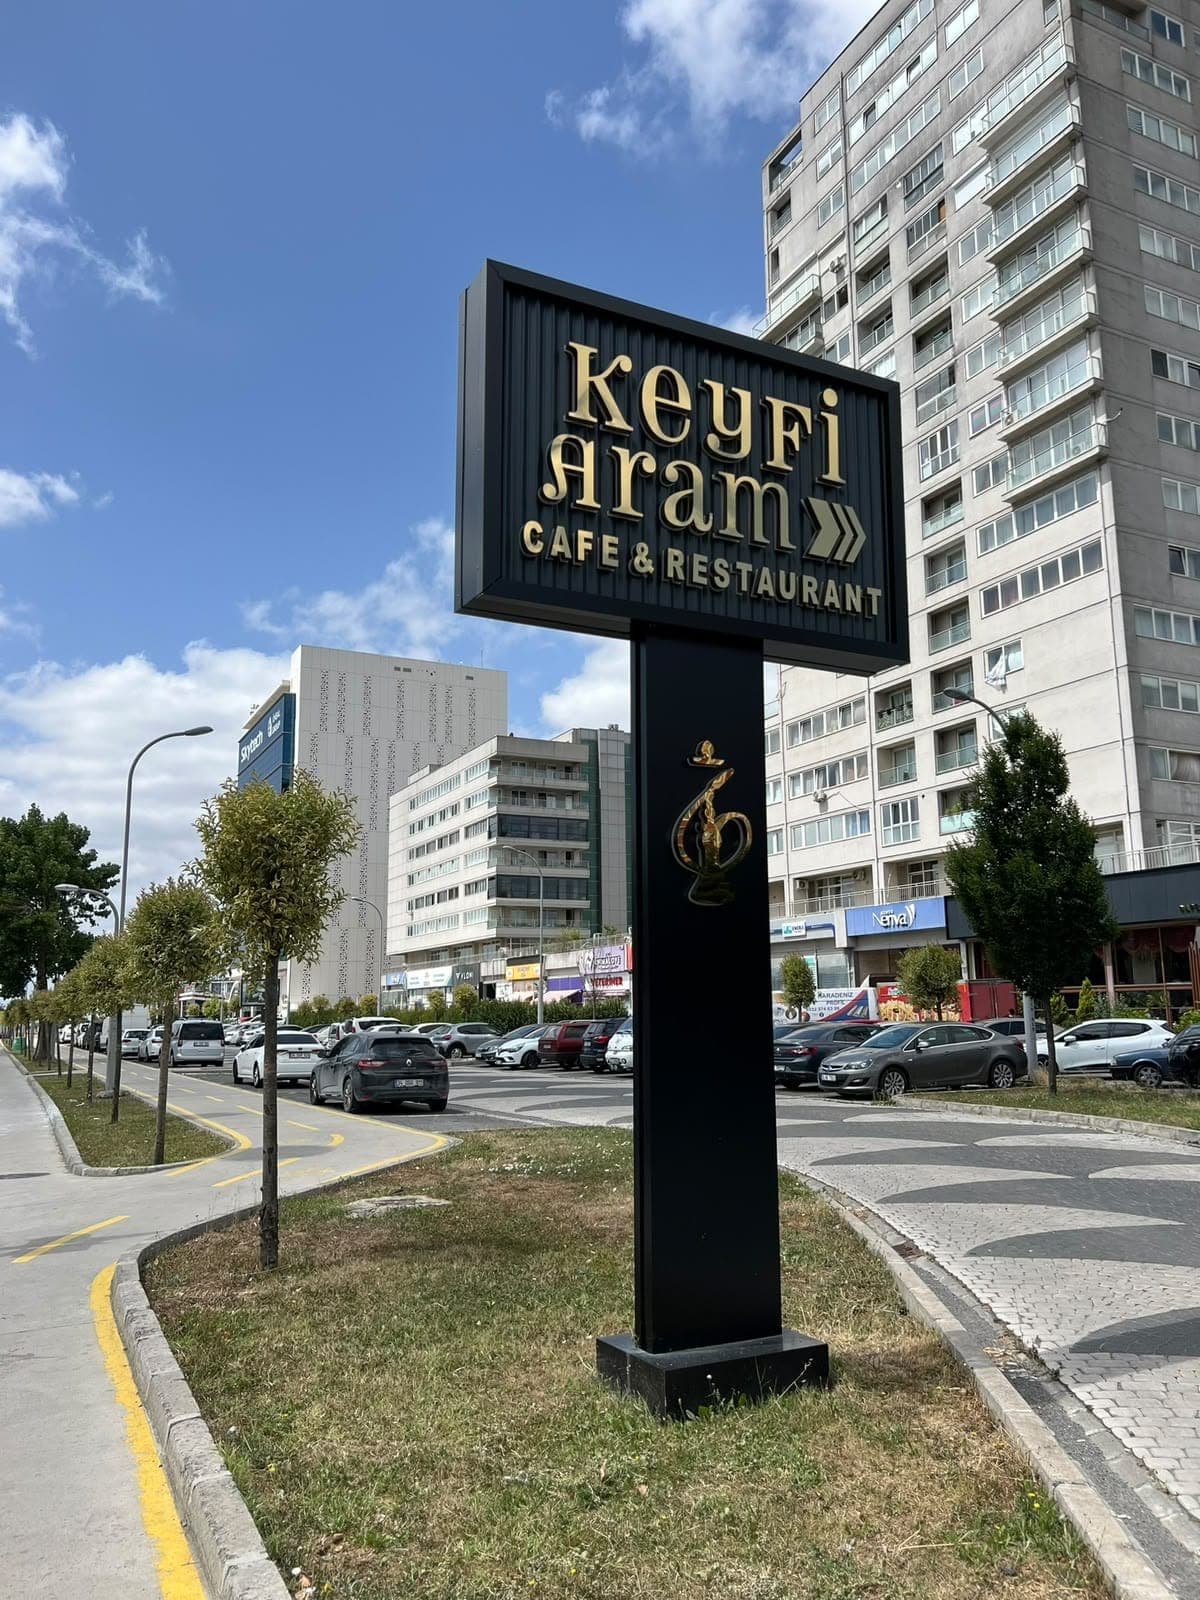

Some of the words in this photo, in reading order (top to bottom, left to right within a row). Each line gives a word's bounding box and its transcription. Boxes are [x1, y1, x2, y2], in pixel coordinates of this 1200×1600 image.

[541, 433, 797, 552] Aram
[522, 519, 620, 568] CAFE
[633, 542, 655, 574] &
[666, 547, 882, 617] RESTAURANT
